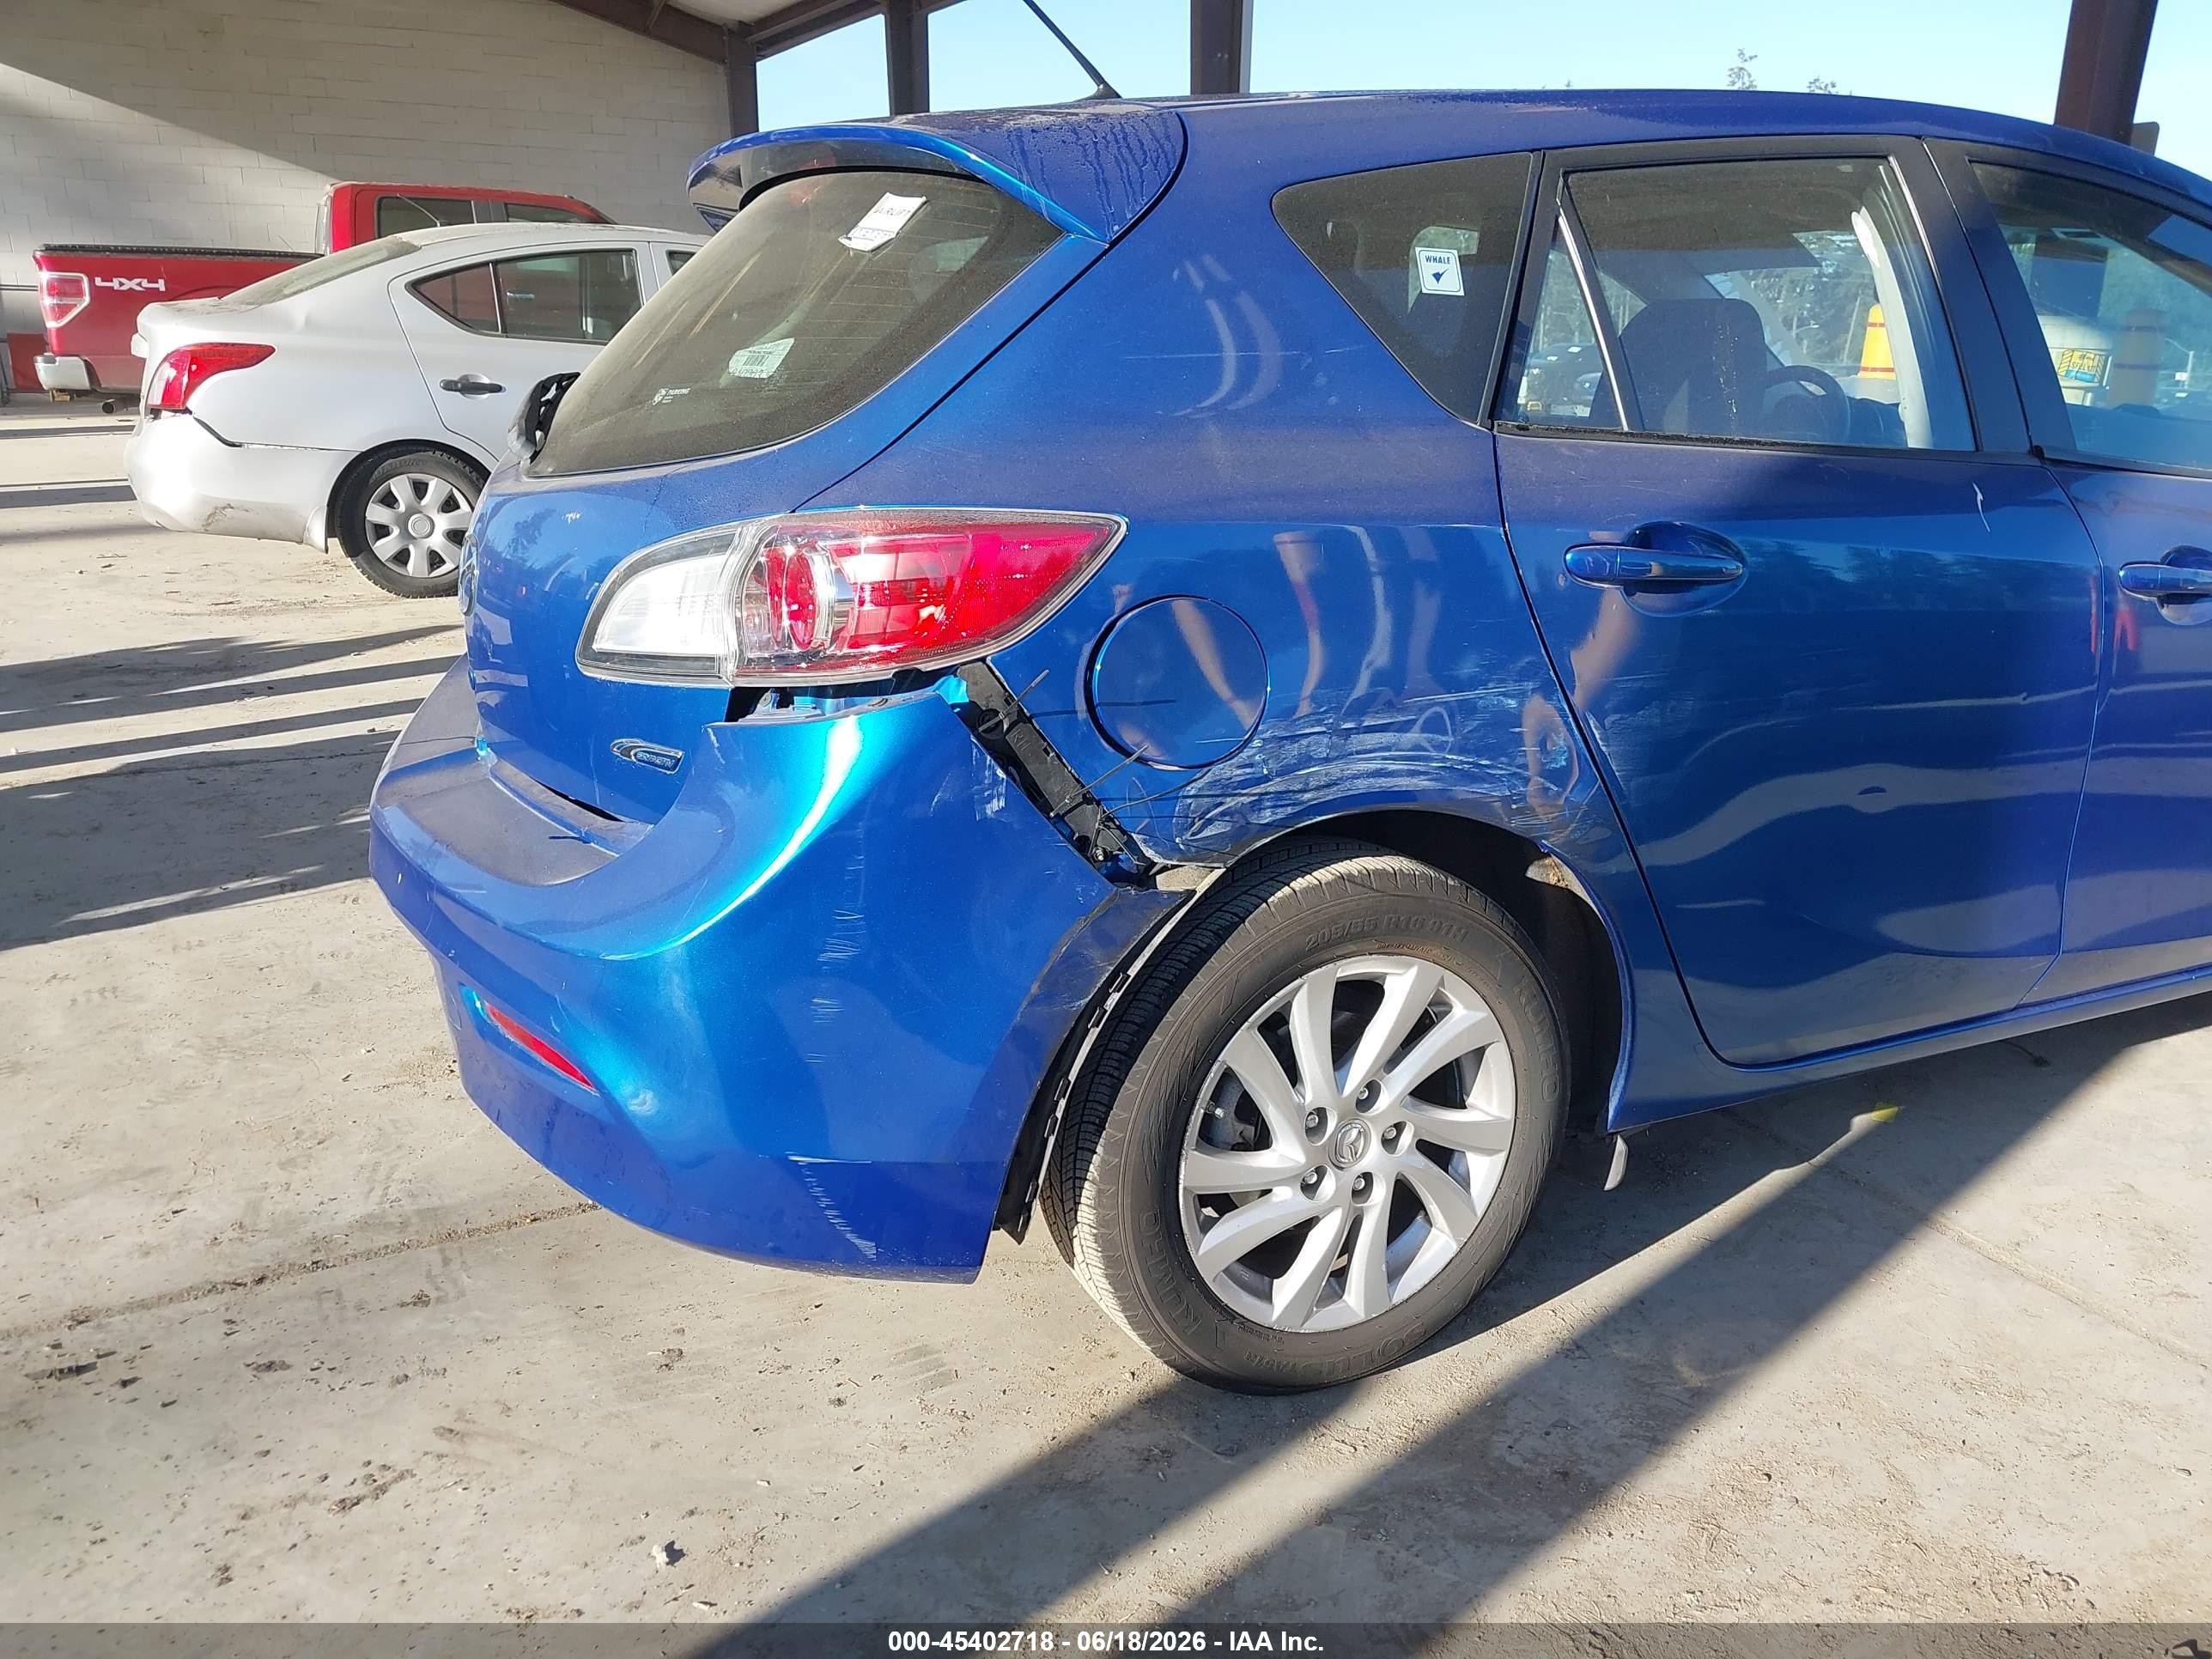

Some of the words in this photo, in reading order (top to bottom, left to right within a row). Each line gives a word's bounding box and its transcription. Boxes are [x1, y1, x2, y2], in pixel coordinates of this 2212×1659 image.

[1425, 255, 1450, 264] WHALE
[1305, 915, 1378, 951] 205/55
[1511, 974, 1560, 1102] KUMHO
[1138, 1208, 1203, 1335] KUMHO
